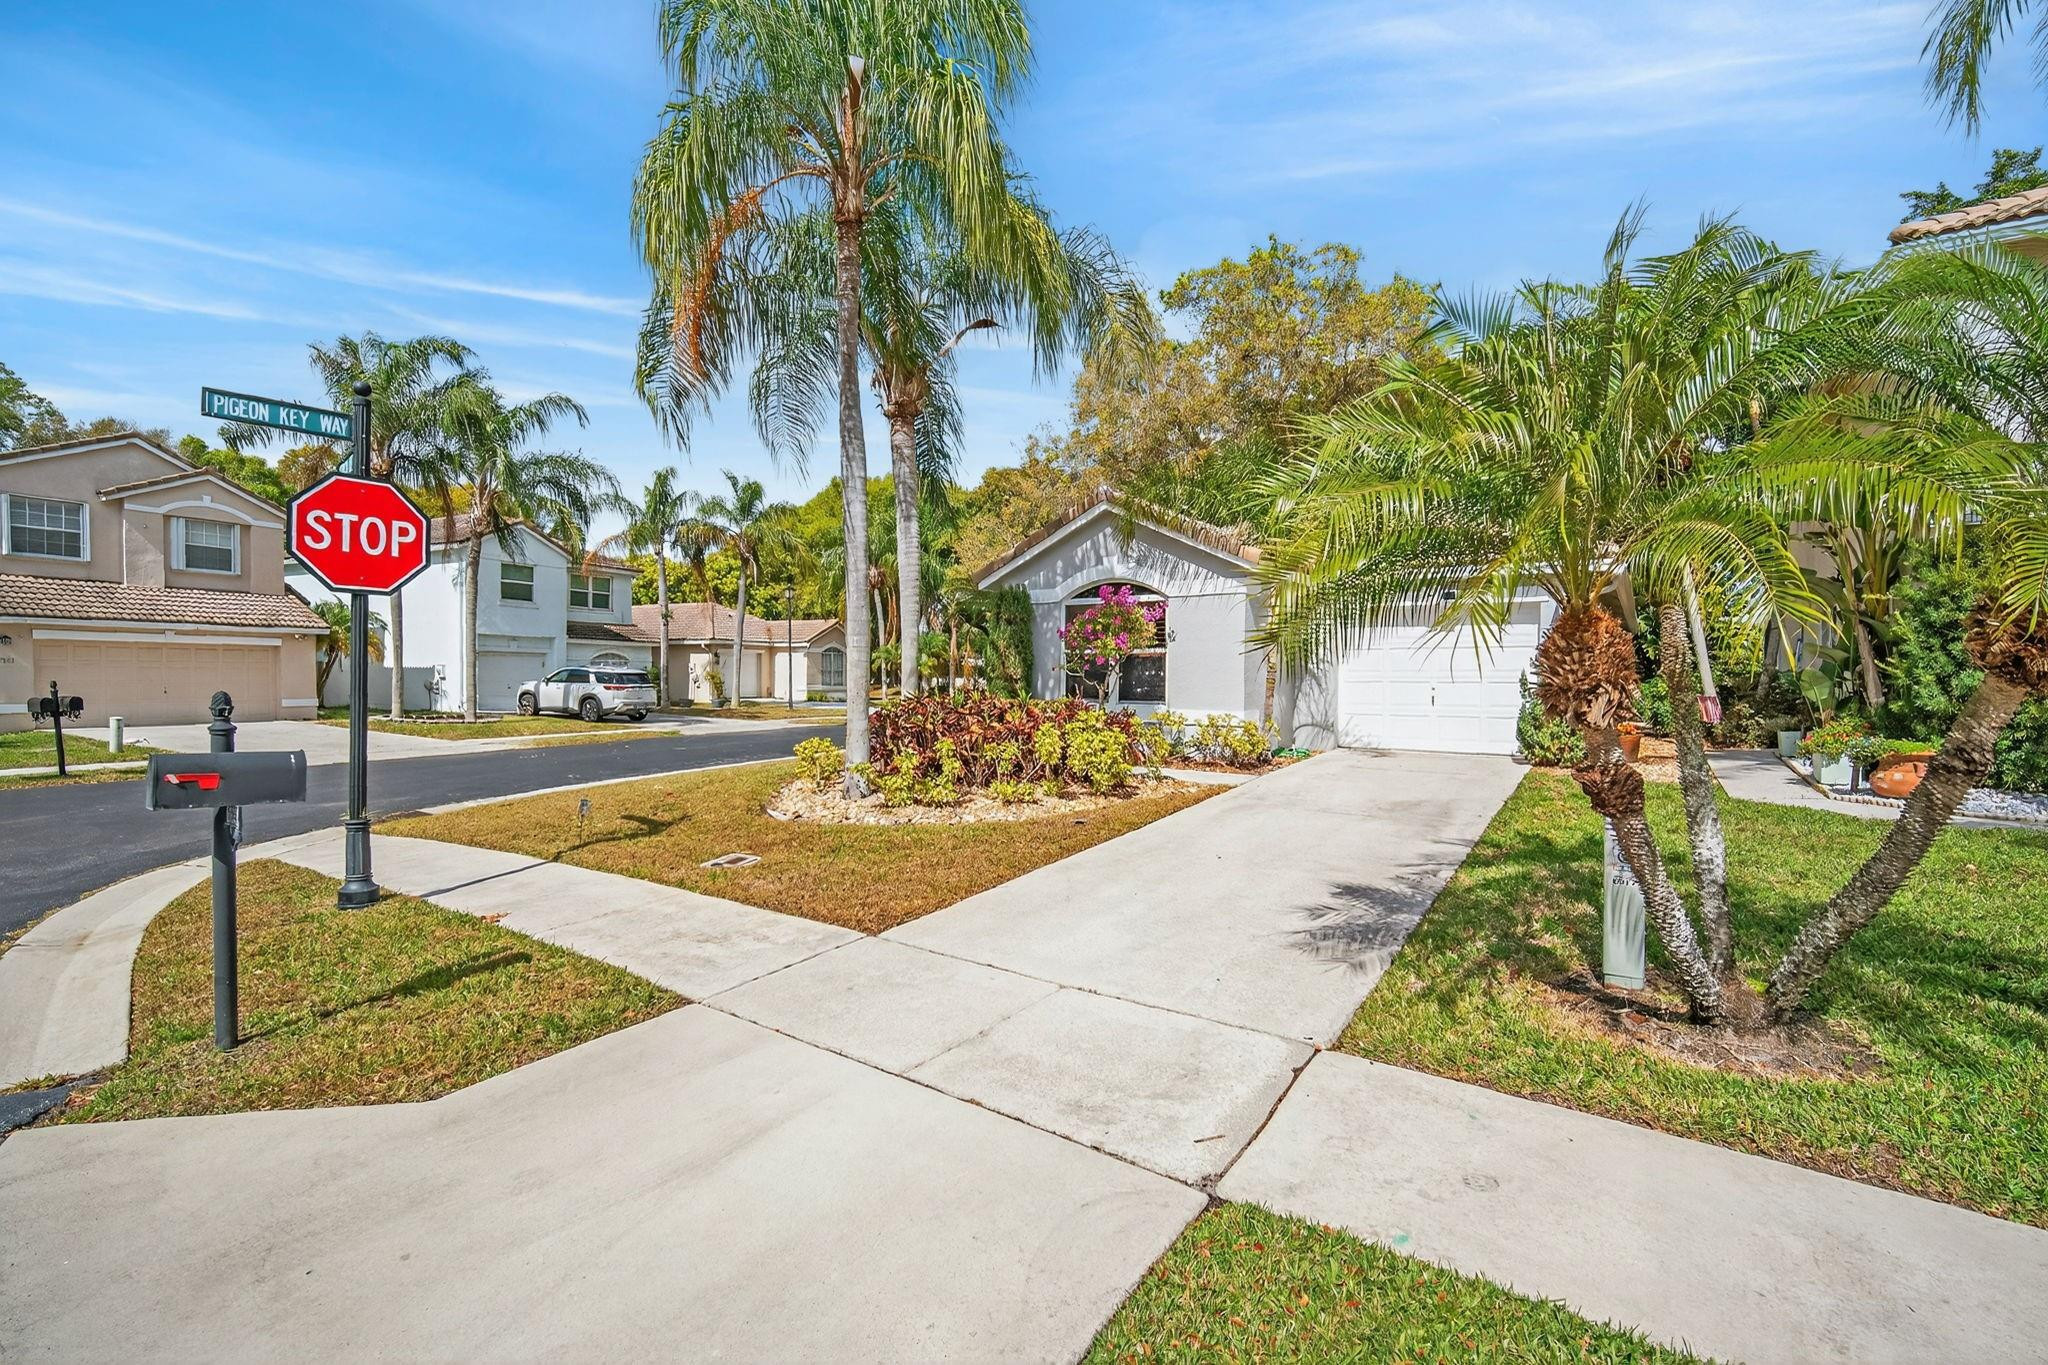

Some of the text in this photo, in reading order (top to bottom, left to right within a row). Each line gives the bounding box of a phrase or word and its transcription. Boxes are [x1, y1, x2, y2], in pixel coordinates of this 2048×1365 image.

[213, 394, 349, 436] PIGEON KEY WAY
[304, 509, 417, 558] STOP
